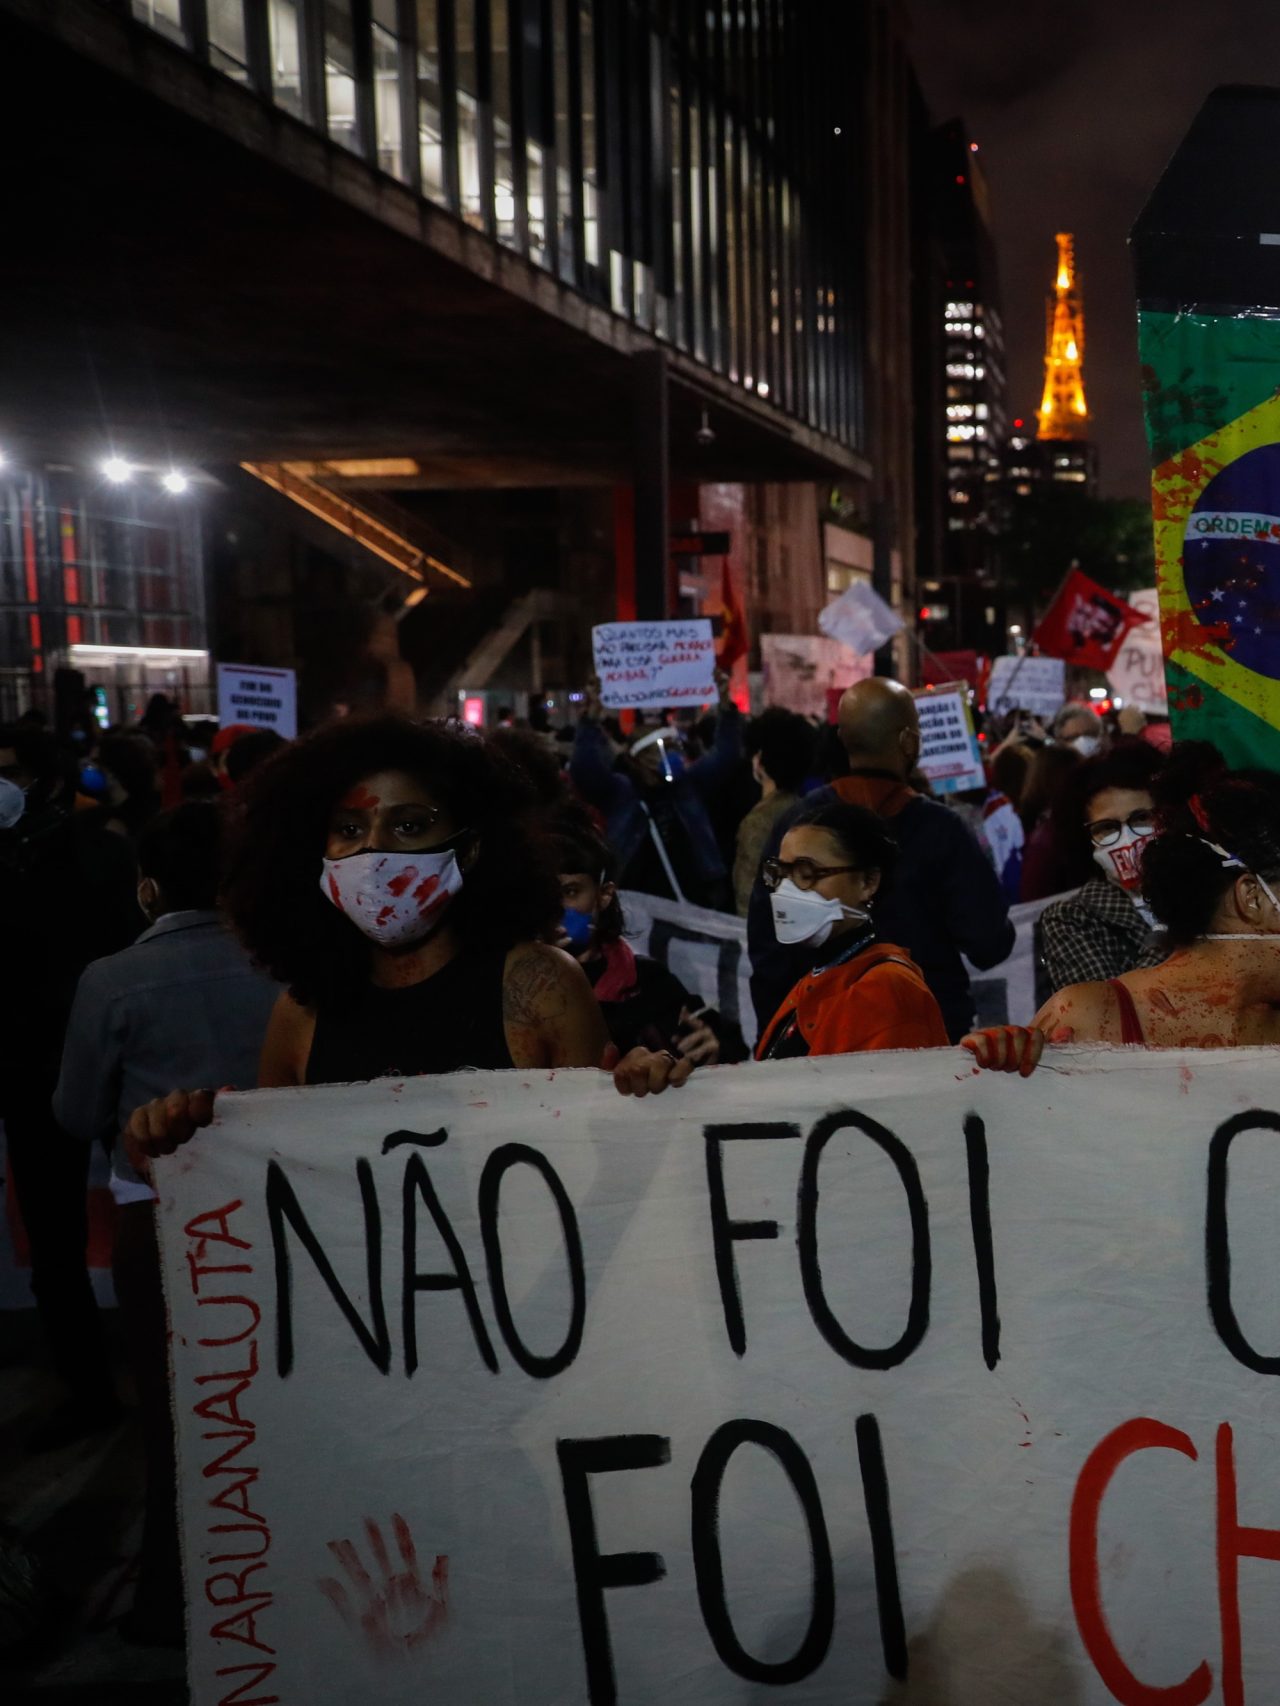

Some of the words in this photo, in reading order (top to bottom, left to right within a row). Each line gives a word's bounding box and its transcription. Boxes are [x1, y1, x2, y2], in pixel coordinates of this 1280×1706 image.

[1195, 516, 1271, 536] ORDEM
[265, 1126, 587, 1379] NÃO
[702, 1105, 1001, 1371] FOI
[556, 1413, 909, 1706] FOI
